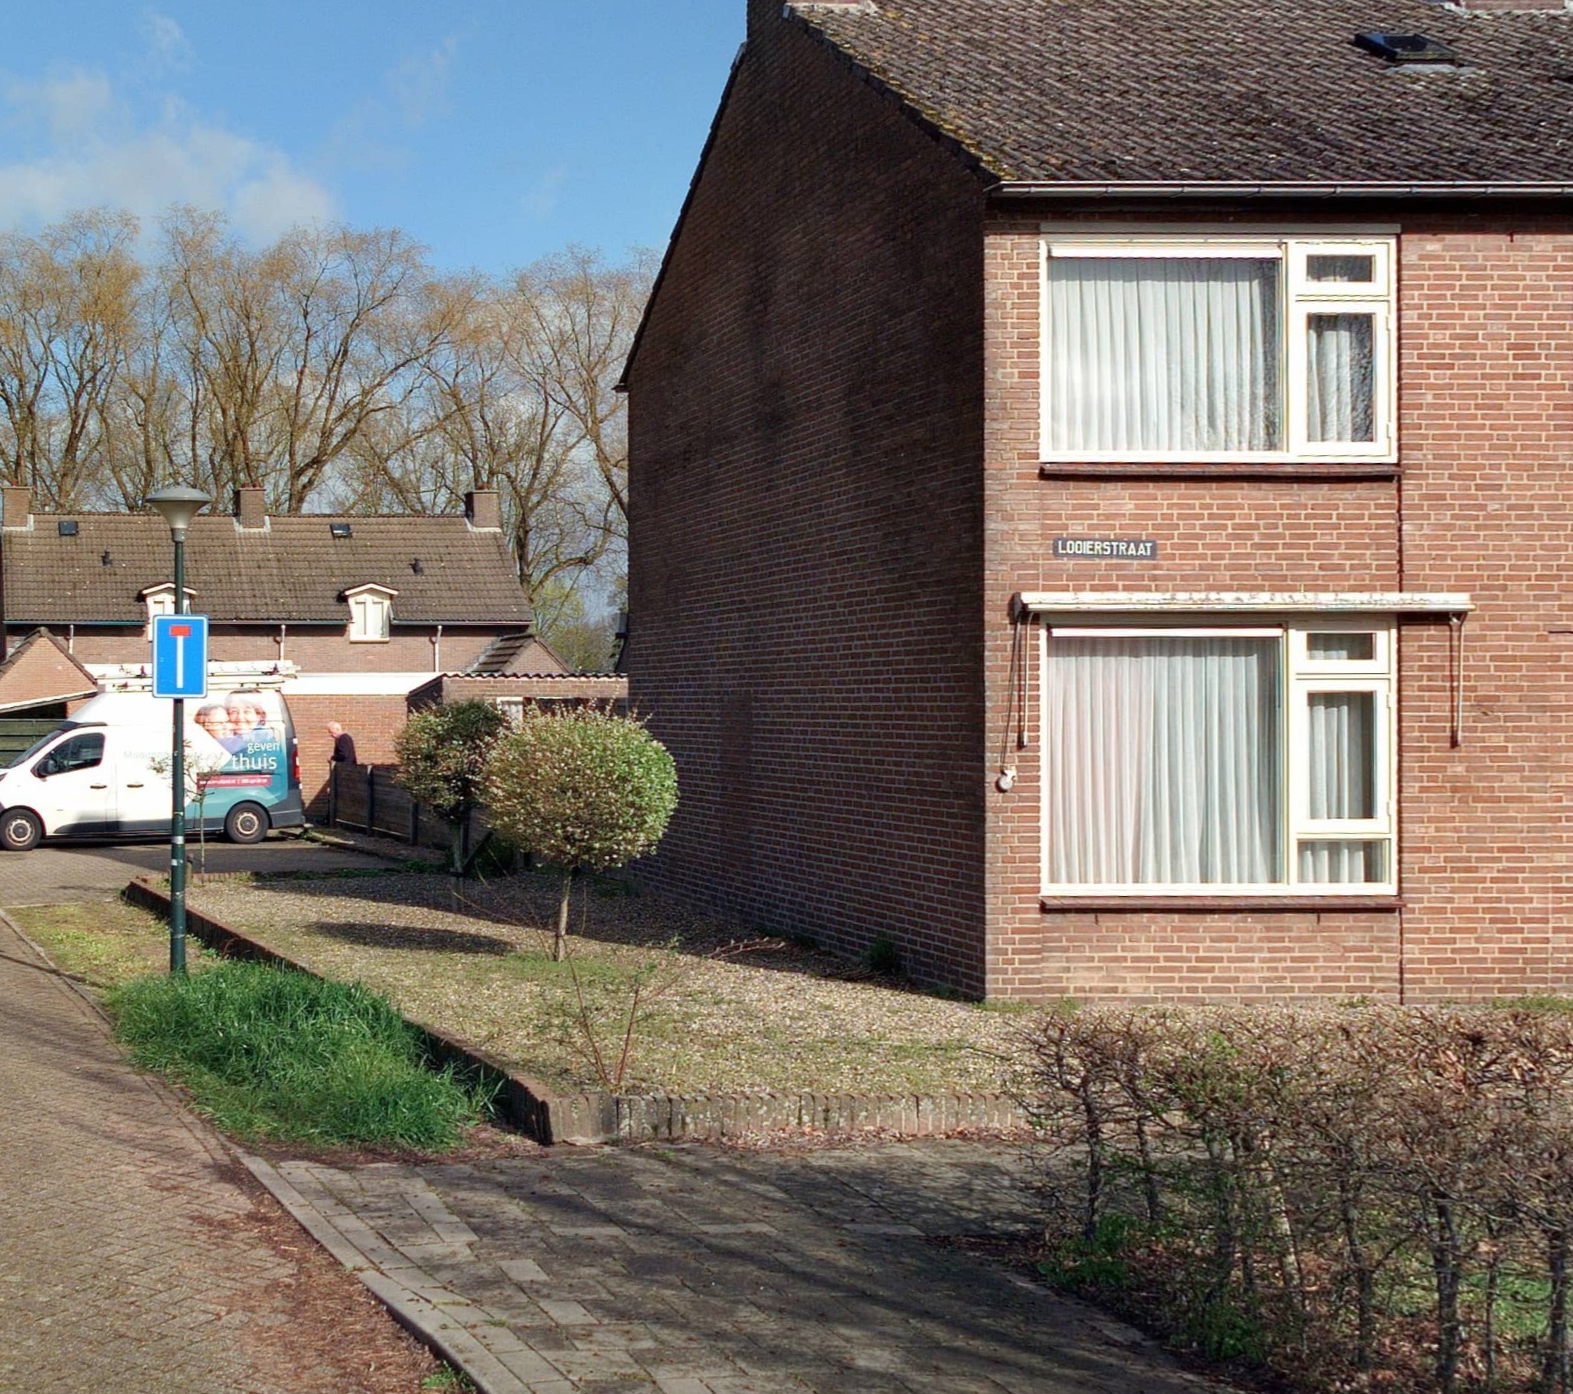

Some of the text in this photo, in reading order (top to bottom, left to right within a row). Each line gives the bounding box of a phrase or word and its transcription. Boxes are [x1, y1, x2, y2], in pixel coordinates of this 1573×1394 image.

[1058, 540, 1153, 556] LOOIERSTRAAT
[247, 741, 280, 754] geven
[232, 753, 278, 770] thuis
